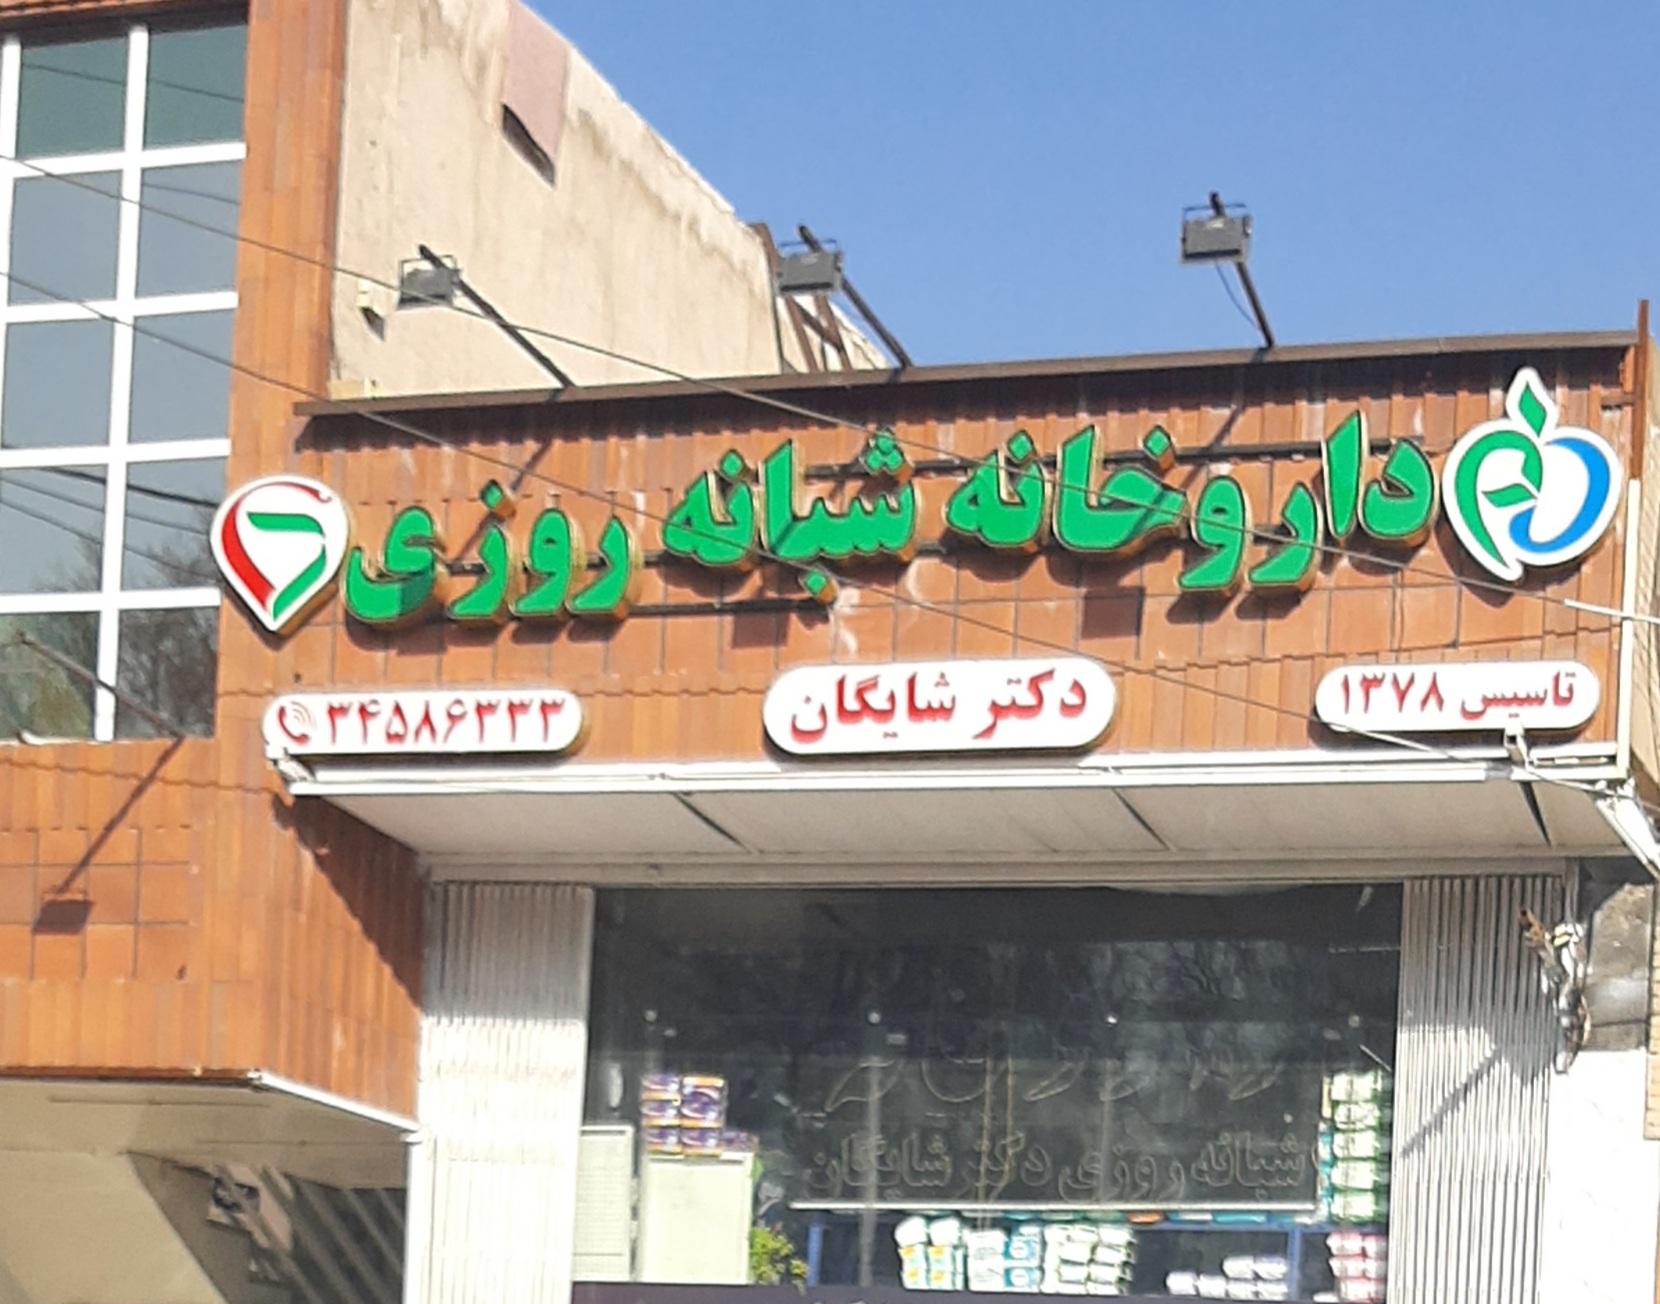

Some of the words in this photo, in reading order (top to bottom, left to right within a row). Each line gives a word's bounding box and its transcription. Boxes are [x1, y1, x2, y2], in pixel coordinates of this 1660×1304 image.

[661, 433, 917, 595] شبانه
[945, 416, 1437, 590] داروخانه
[343, 484, 631, 622] روزی
[326, 698, 565, 744] ۳۴۵۸۶۳۳۳
[789, 672, 957, 744] شایگان
[972, 668, 1088, 740] دکتر
[1340, 671, 1446, 714] ۱۳۷۸
[1459, 671, 1577, 721] تاسیس
